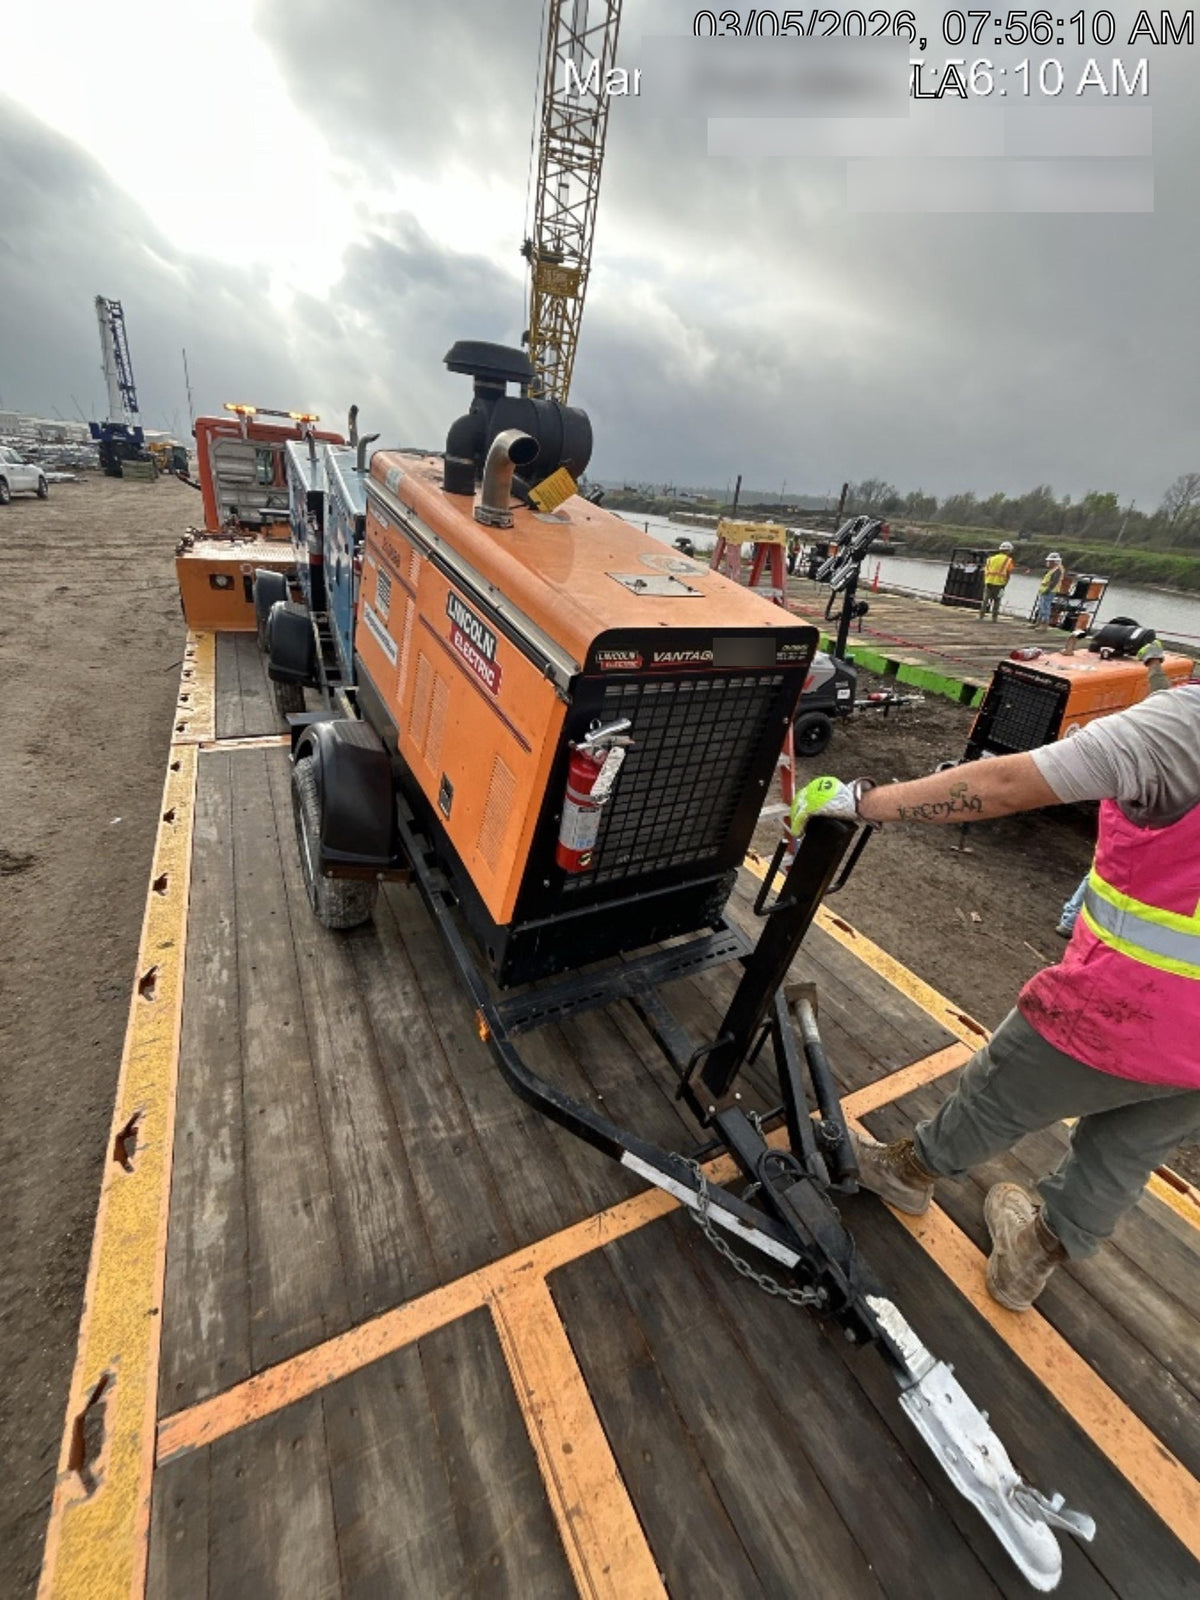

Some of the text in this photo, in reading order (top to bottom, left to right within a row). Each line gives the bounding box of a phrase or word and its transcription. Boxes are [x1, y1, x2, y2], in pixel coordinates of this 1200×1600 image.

[448, 594, 495, 661] LINCOLN
[454, 633, 495, 688] ELECTRIC
[653, 650, 713, 662] VANTAG
